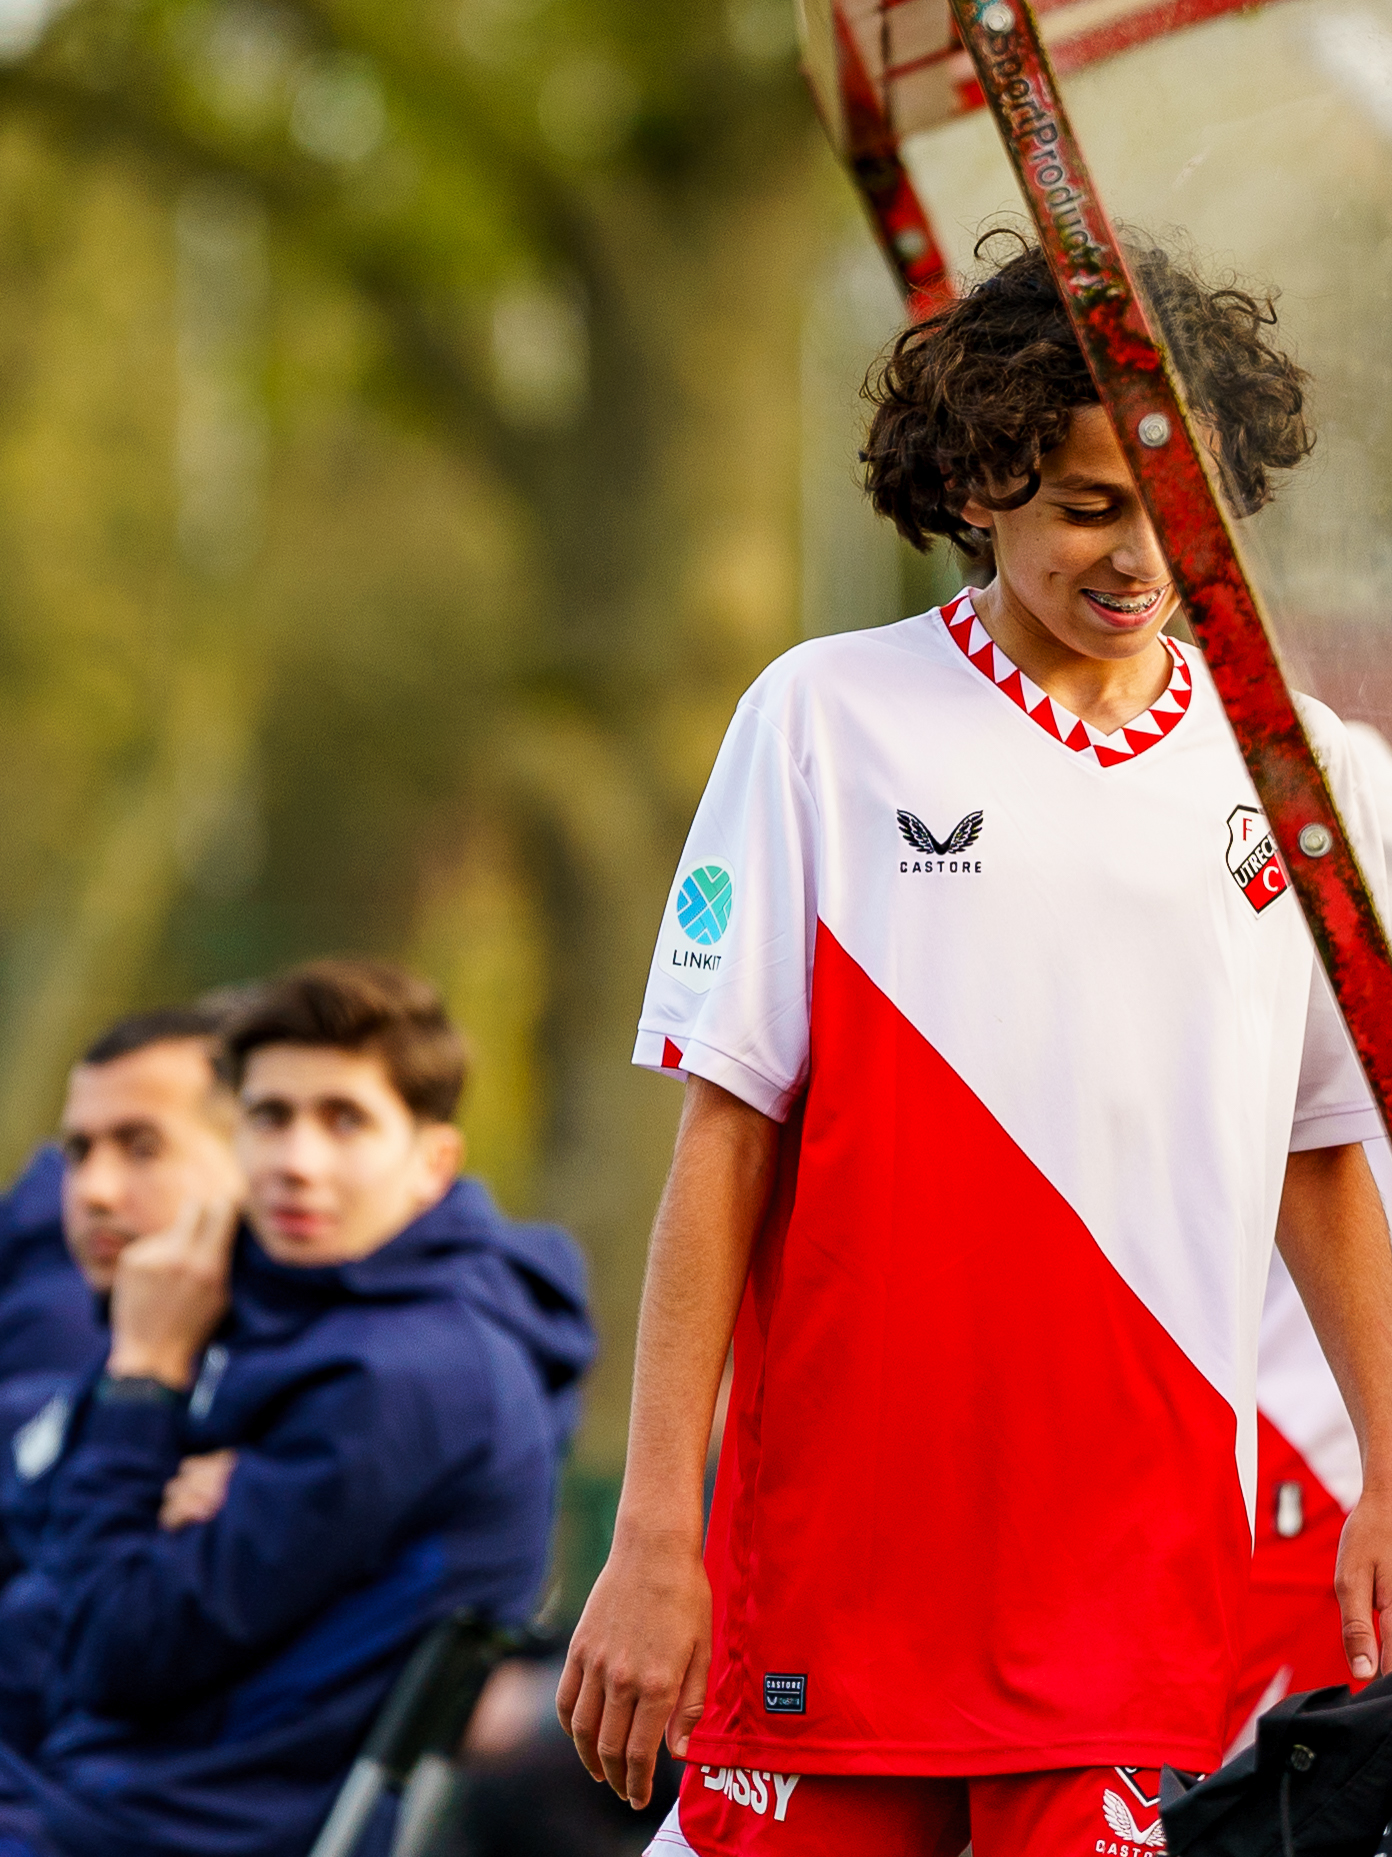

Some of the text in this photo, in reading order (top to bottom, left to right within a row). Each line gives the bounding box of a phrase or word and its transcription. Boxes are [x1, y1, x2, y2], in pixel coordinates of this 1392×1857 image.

[1243, 817, 1253, 841] F
[900, 860, 982, 874] CASTORE
[1263, 866, 1279, 892] C
[672, 949, 722, 971] LINKIT
[766, 1680, 801, 1690] CASTORE
